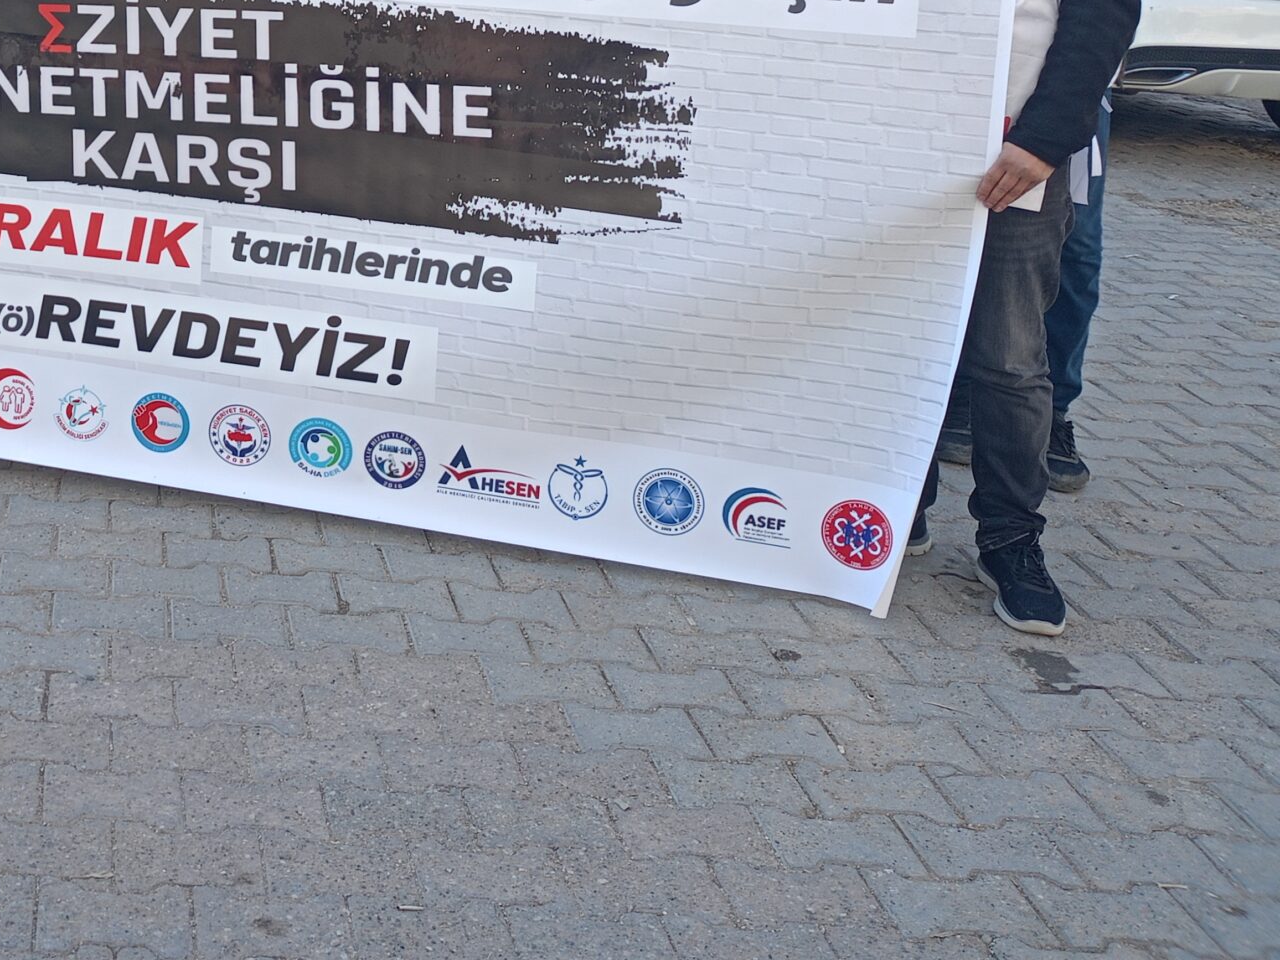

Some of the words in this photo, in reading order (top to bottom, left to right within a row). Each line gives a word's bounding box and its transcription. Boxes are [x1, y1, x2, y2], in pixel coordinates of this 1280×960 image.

[71, 129, 298, 204] KARŞI
[230, 229, 515, 294] tarihlerinde
[744, 514, 786, 530] ASEF
